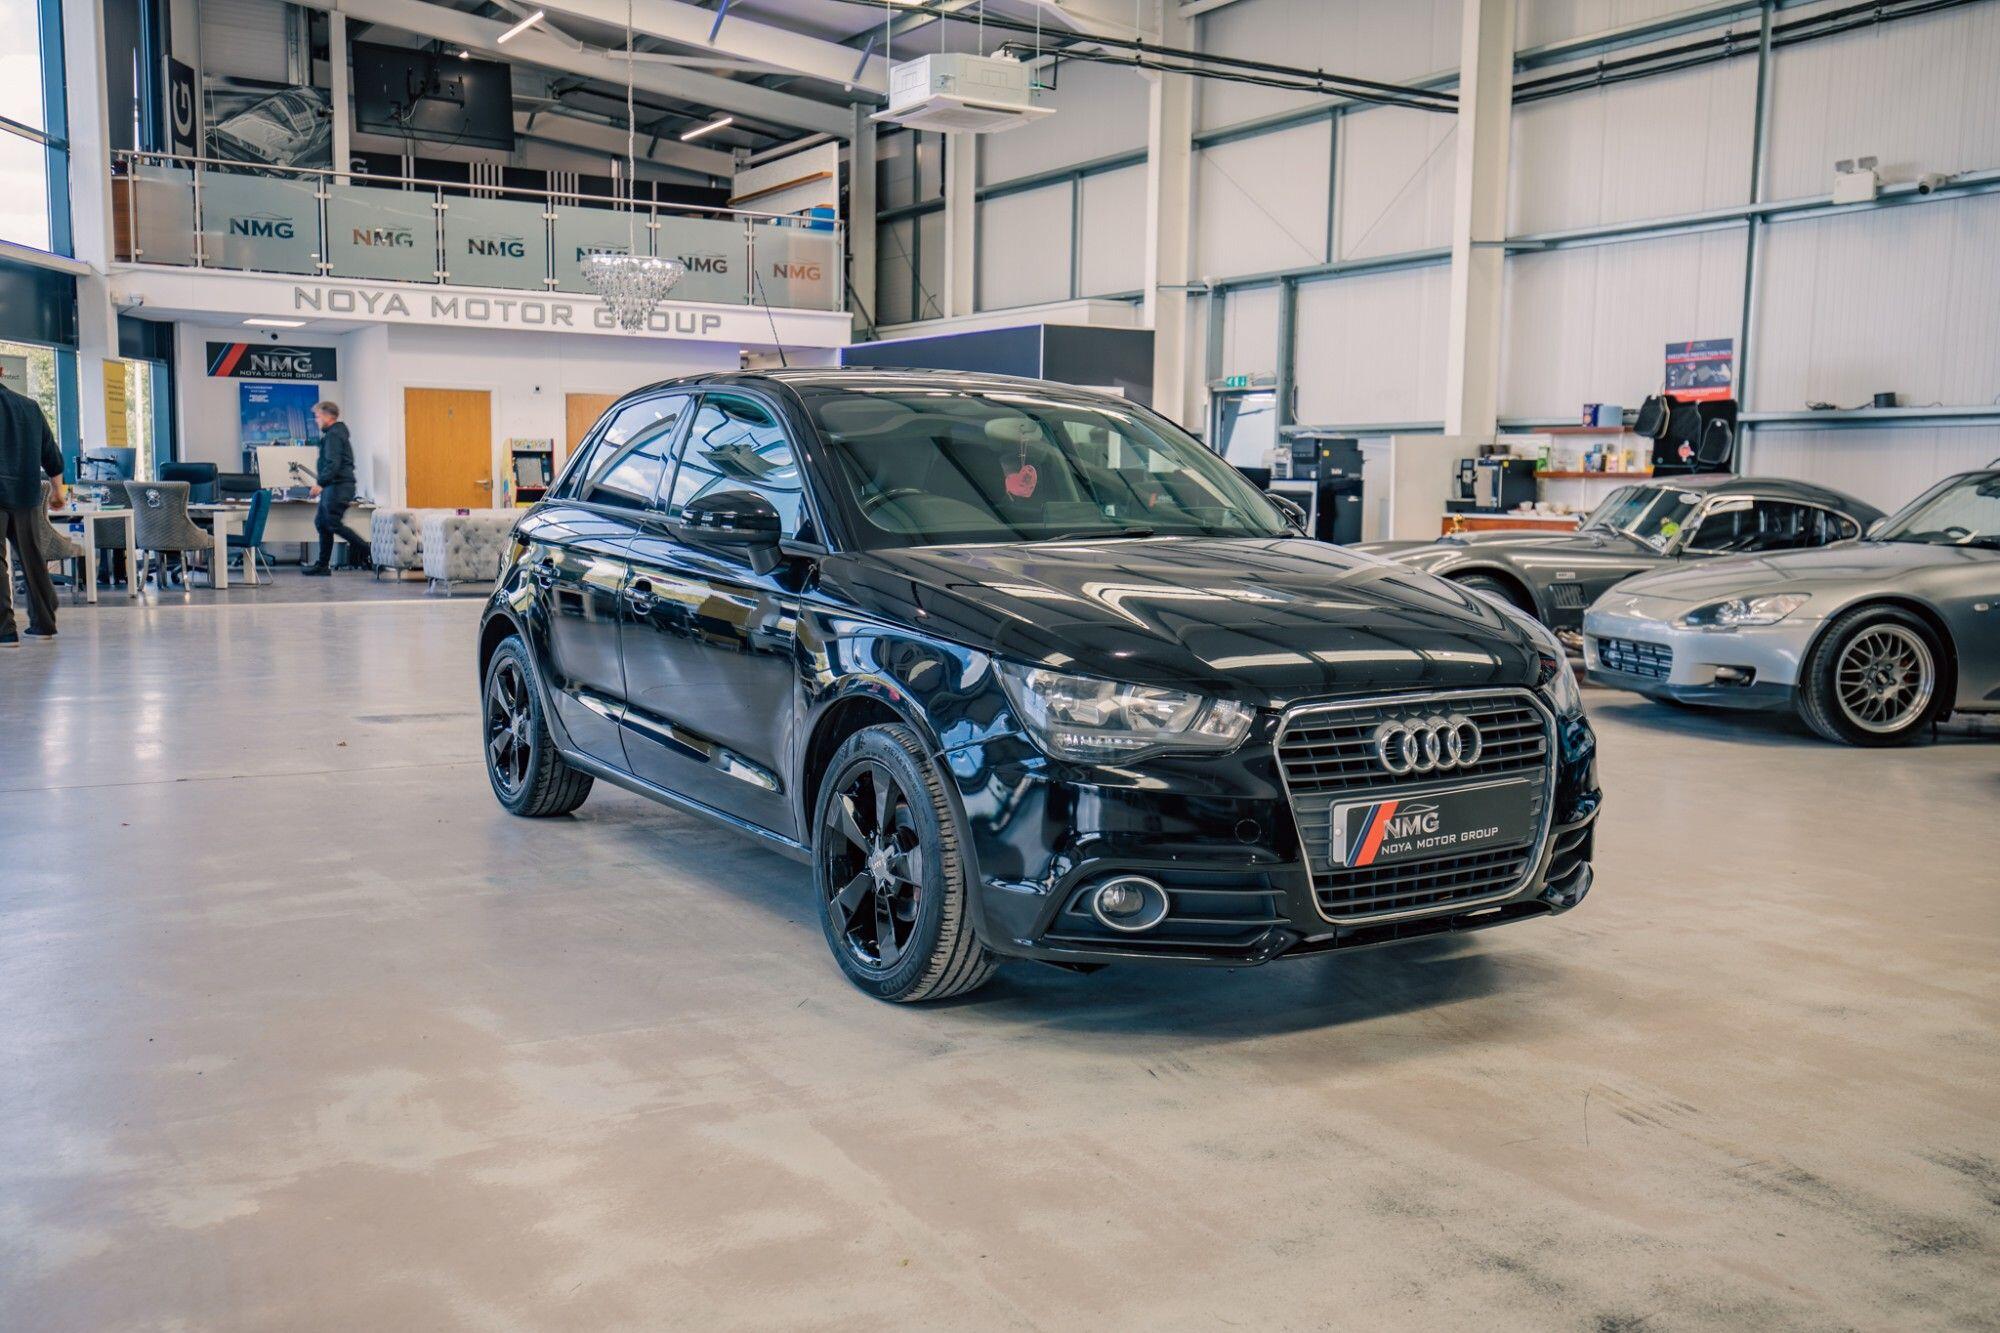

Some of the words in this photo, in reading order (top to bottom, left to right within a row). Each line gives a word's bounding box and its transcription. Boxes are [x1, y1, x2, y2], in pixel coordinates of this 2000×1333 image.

[229, 217, 294, 240] NMG
[353, 229, 414, 248] NMG
[468, 238, 525, 258] NMG
[773, 263, 821, 281] NMG
[294, 286, 410, 316] NOYA
[431, 295, 573, 326] MOTOR
[594, 306, 721, 335] GOUP
[250, 354, 313, 373] NMG
[1382, 812, 1440, 841] NMG
[1381, 841, 1412, 856] NOYA
[1416, 833, 1457, 849] MOTOR
[1460, 826, 1499, 843] GROUP
